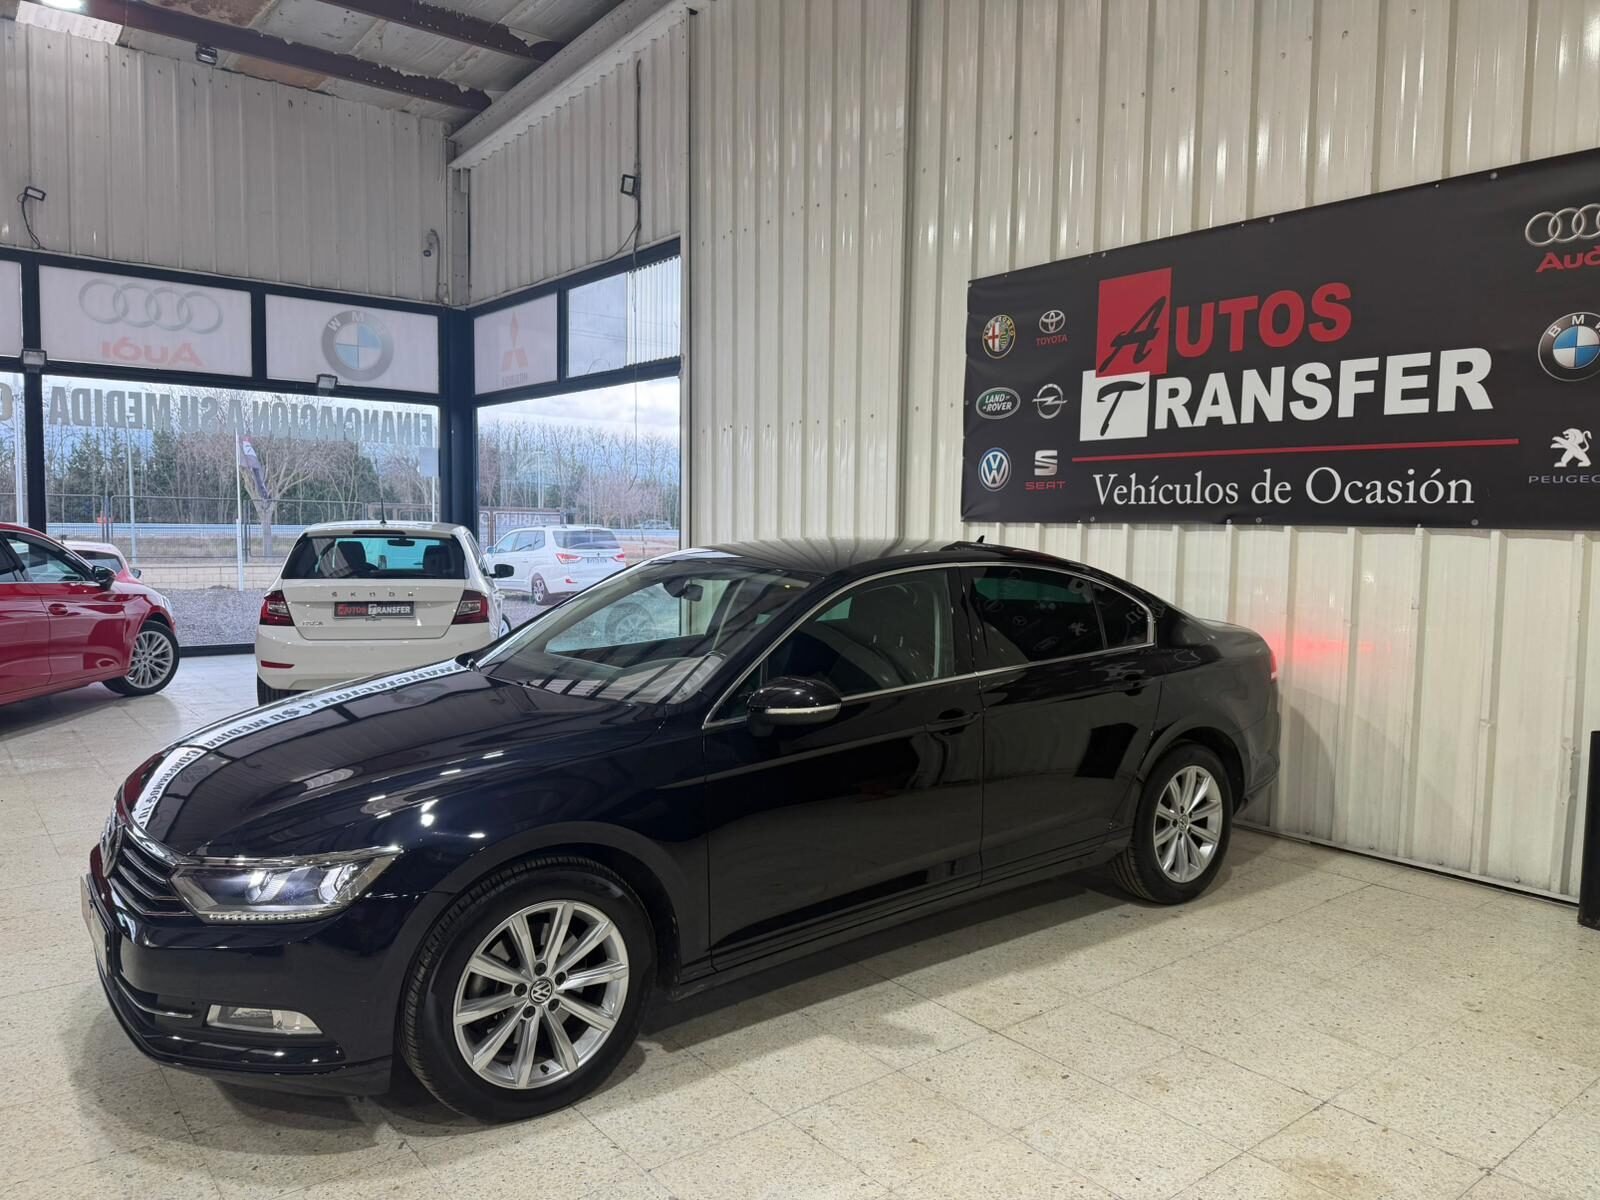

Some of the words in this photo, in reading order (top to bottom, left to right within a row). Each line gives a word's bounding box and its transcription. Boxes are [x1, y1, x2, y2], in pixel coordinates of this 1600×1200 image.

[1536, 245, 1600, 272] Aud
[1096, 278, 1353, 374] AUTOS
[1548, 314, 1600, 337] BM
[1036, 334, 1068, 346] TOYOTA
[985, 393, 1006, 404] LAND
[1090, 347, 1494, 438] TRANSFER
[986, 402, 1012, 412] ROVER
[1528, 474, 1600, 484] PEUGEO
[1024, 480, 1066, 491] SEAT
[1092, 470, 1239, 506] Vehículos
[1250, 468, 1292, 505] de
[1305, 466, 1475, 505] Ocasión
[368, 604, 411, 615] TRANSFER
